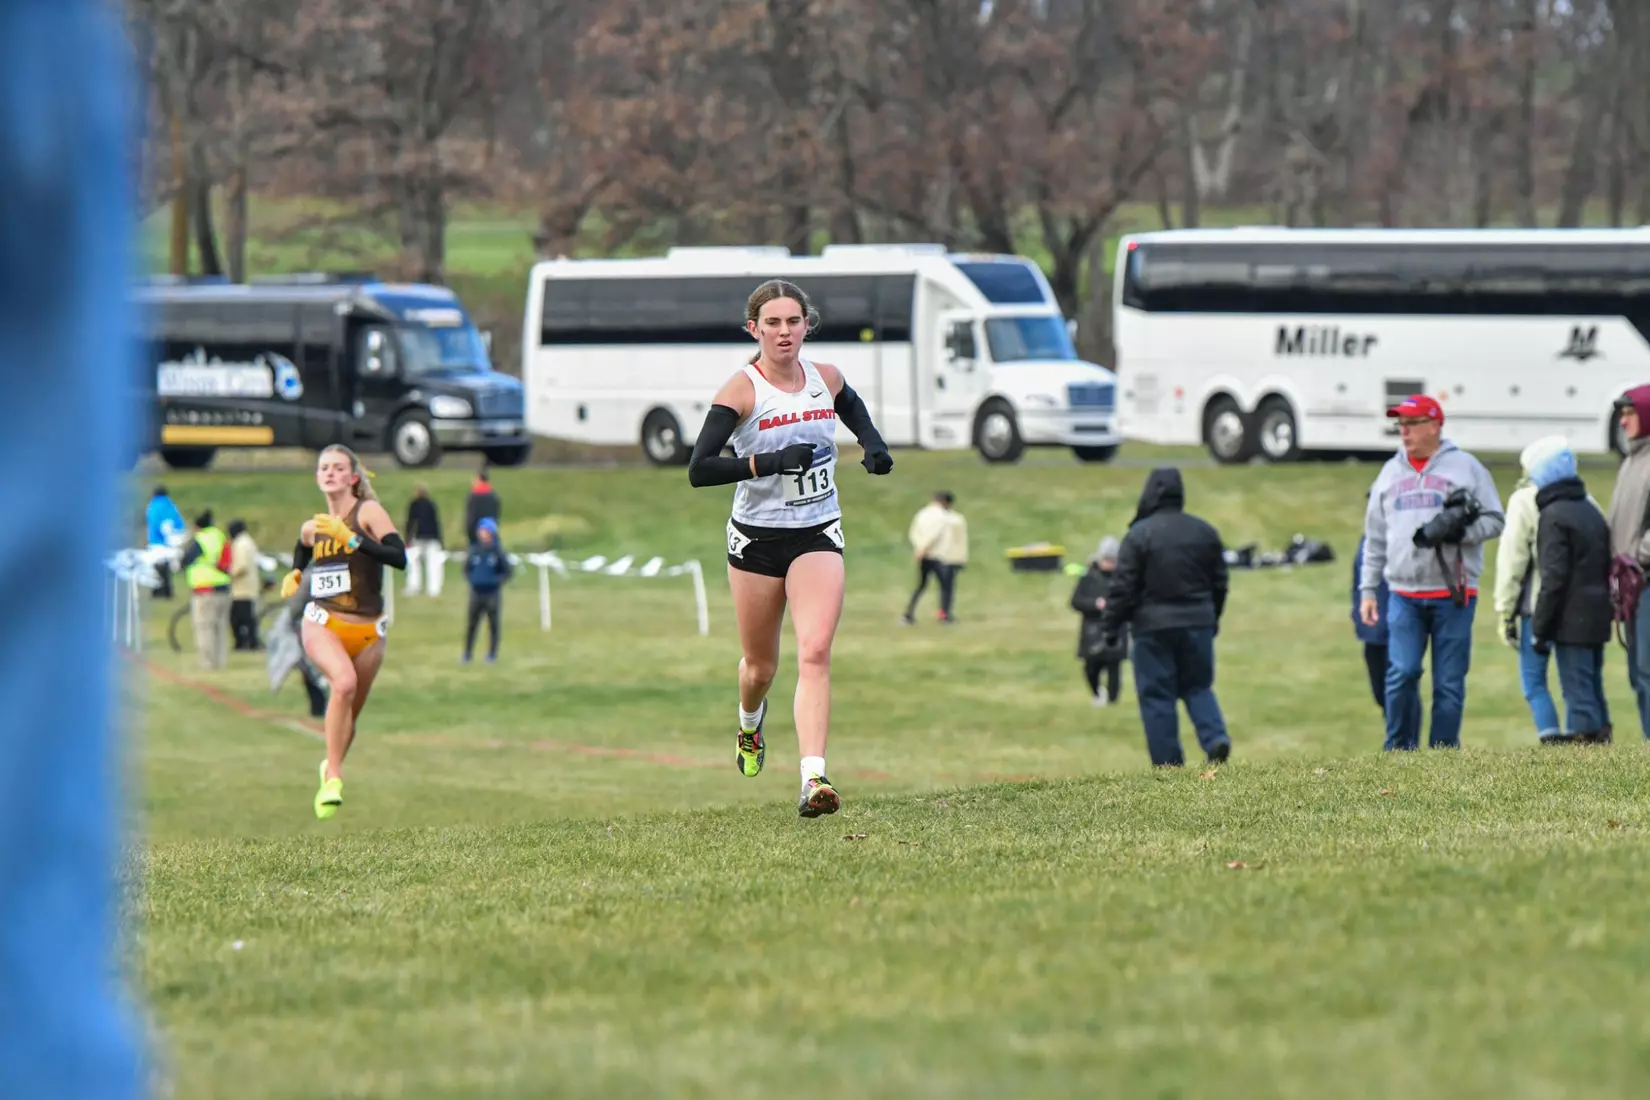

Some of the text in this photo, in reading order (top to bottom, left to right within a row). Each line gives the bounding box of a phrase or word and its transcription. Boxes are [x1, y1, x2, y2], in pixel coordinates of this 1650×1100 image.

[1275, 325, 1378, 357] Miller
[759, 409, 835, 431] BALL STAT
[794, 468, 829, 496] 113
[318, 574, 342, 590] 351
